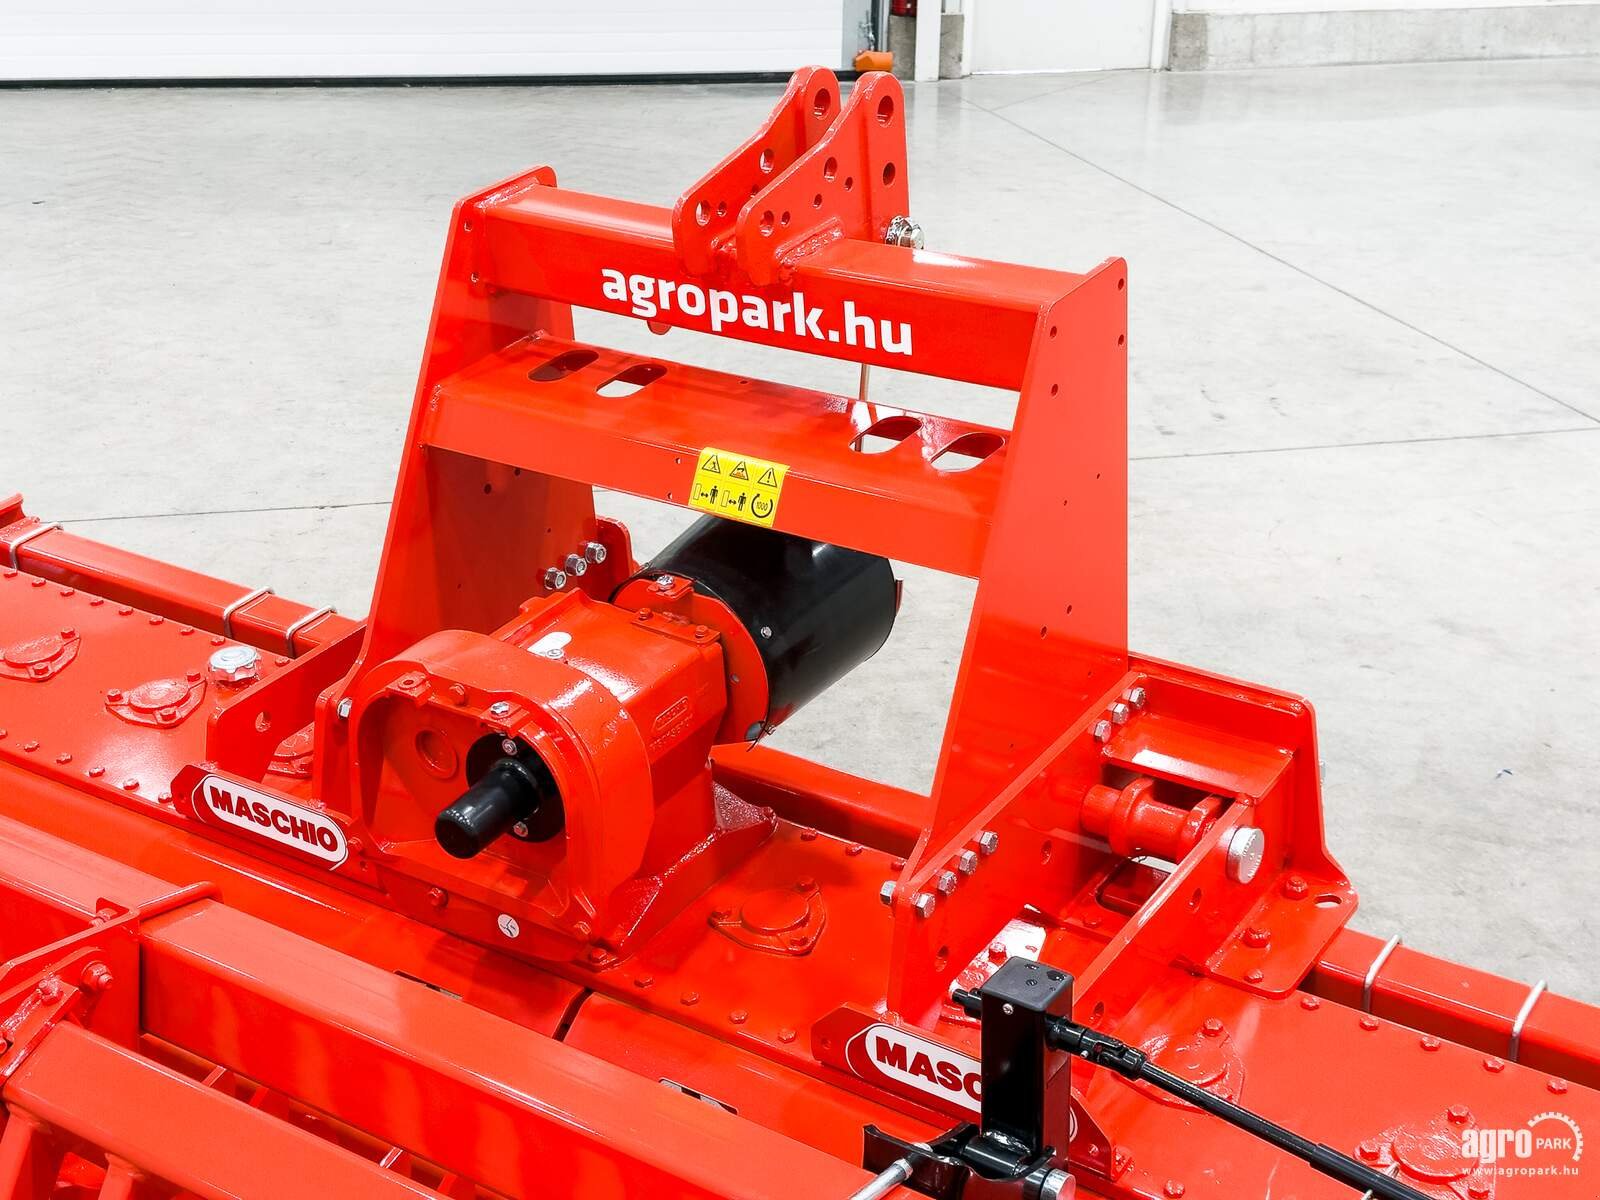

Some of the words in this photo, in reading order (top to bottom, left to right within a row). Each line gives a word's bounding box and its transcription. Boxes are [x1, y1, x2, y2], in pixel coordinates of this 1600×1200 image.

[602, 268, 912, 355] agropark.hu
[210, 785, 338, 852] MASCHIO
[875, 1036, 981, 1102] MASC
